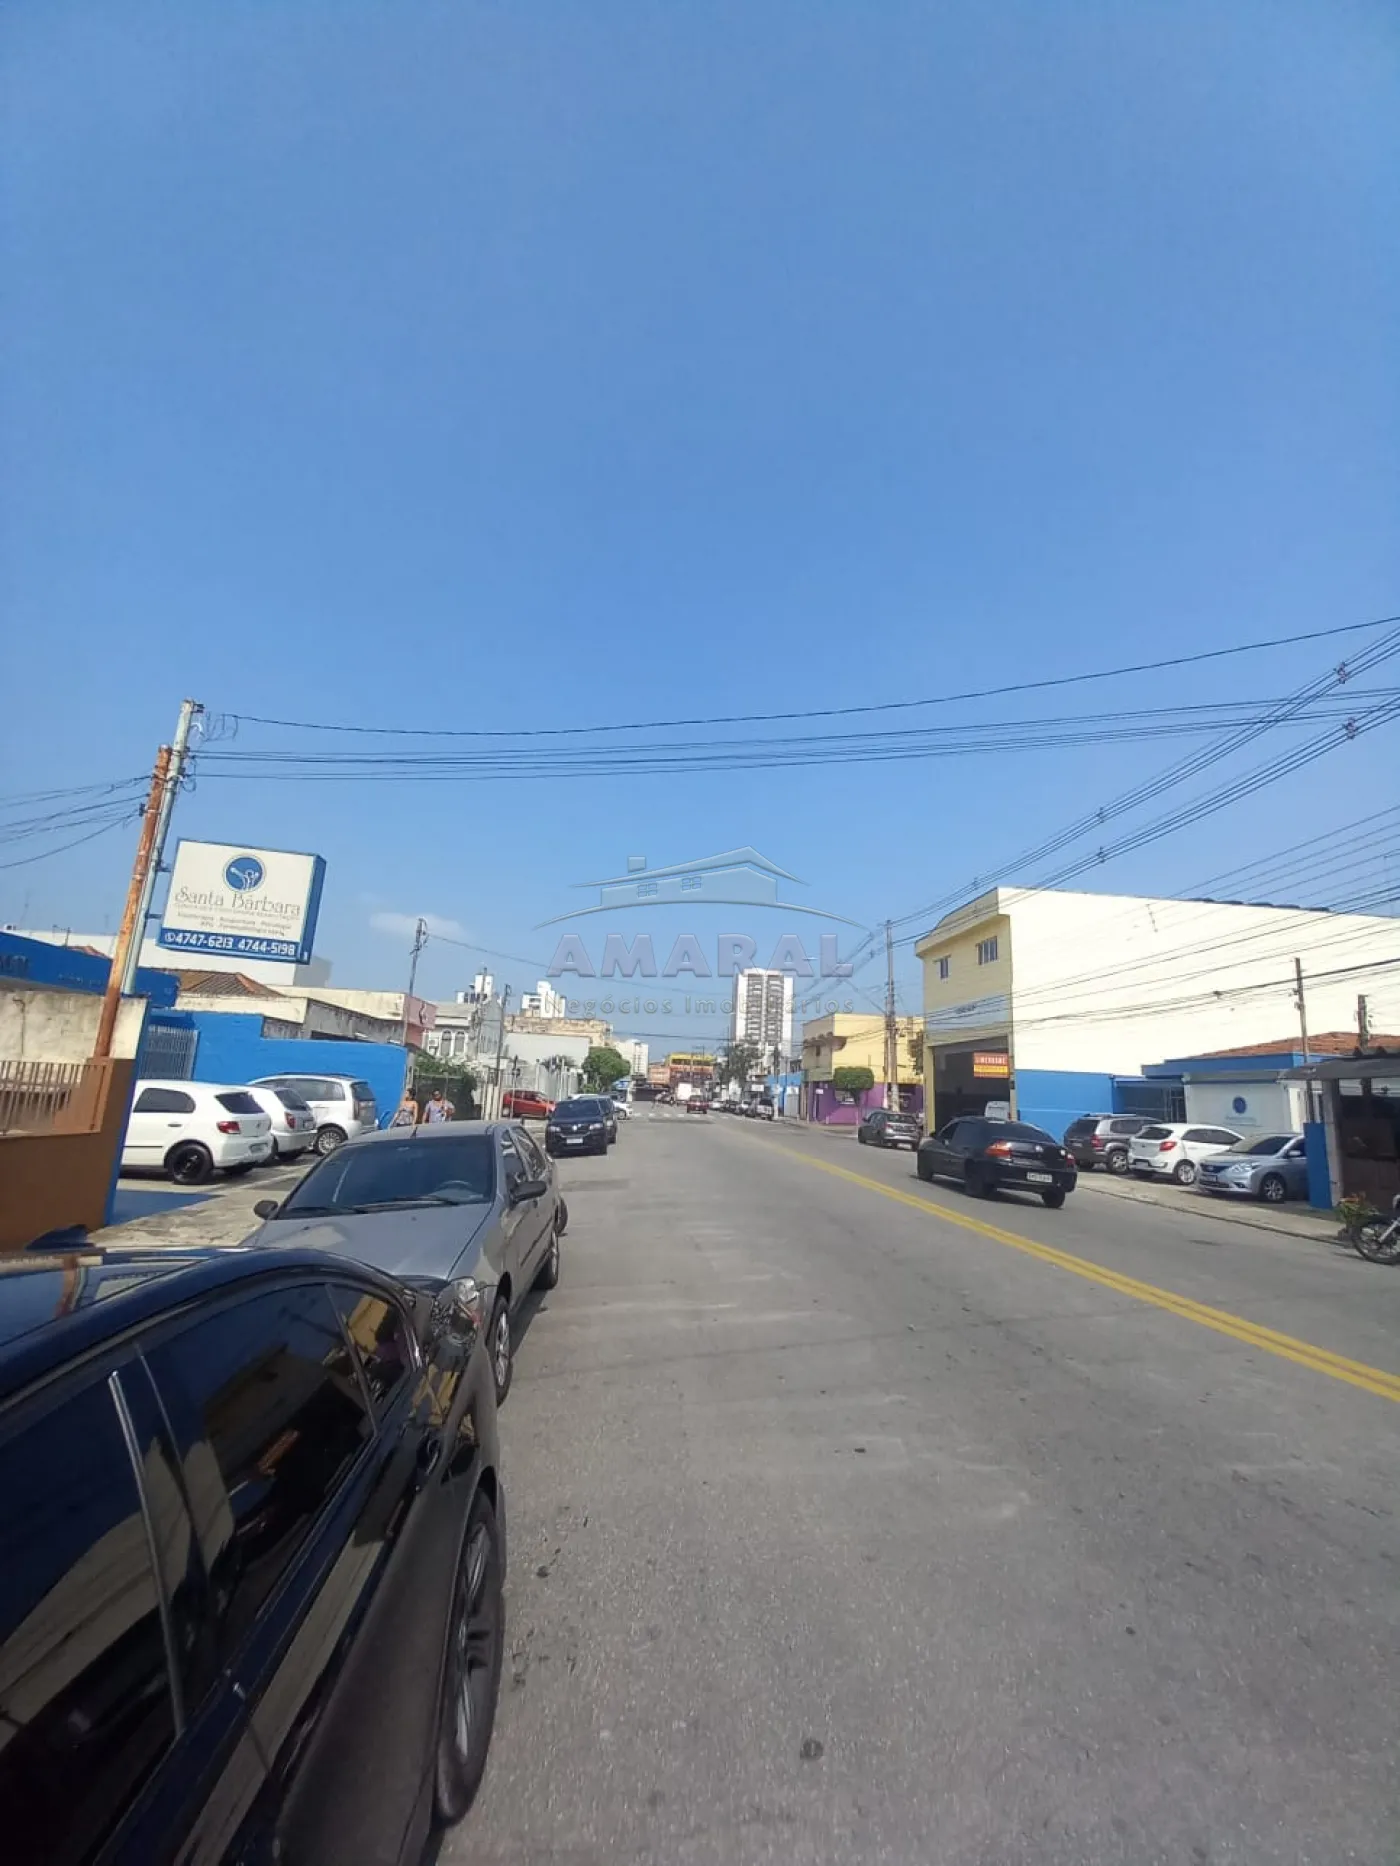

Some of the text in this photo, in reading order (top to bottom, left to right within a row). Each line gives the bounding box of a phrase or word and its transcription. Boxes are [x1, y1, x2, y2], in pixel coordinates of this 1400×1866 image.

[175, 886, 223, 906] Santa
[231, 891, 300, 915] Bárbara
[175, 932, 296, 956] 4747-6213 4744-5198
